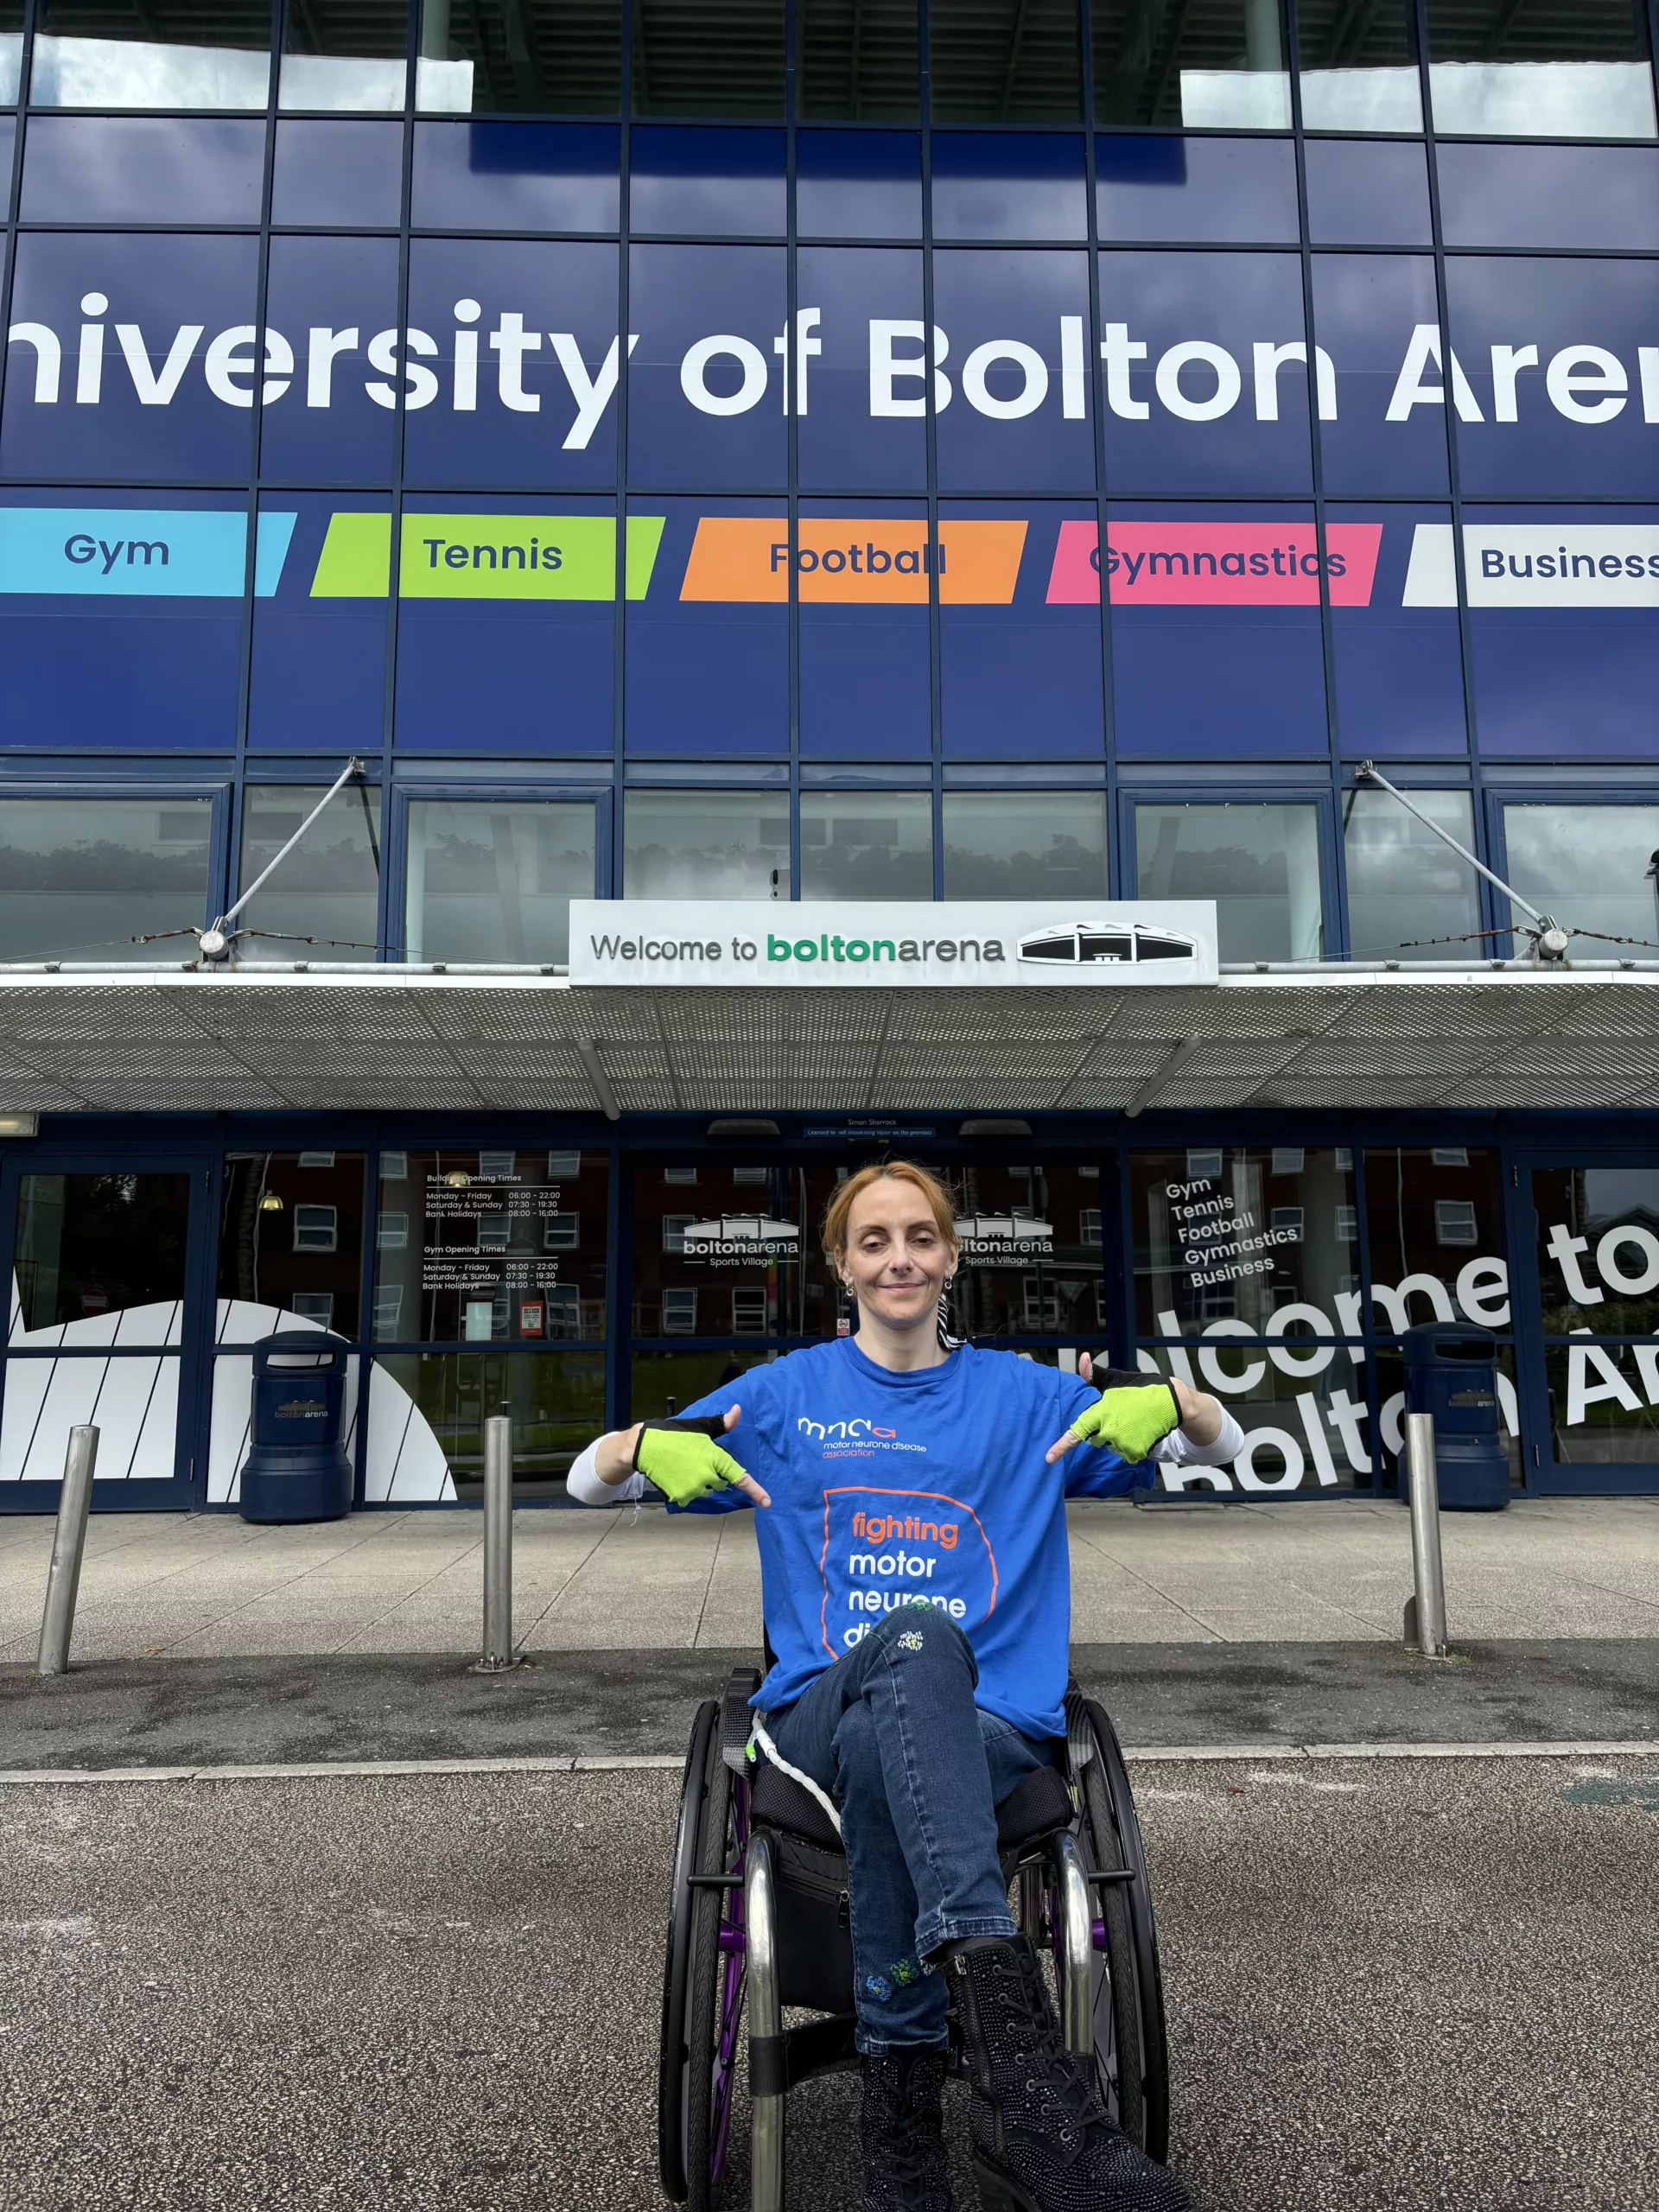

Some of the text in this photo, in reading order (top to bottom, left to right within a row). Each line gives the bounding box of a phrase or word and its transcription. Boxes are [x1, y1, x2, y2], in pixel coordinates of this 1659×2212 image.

[680, 308, 822, 416] of
[869, 315, 1338, 422] Bolton
[64, 534, 169, 575] Gym
[423, 537, 563, 570] Tennis
[770, 543, 946, 575] Football
[1090, 544, 1346, 585] Gymnastics
[590, 933, 1006, 962] Welcome to boltonarena
[427, 1173, 522, 1184] Building Opening Times
[426, 1192, 460, 1202] Monday
[467, 1192, 493, 1202] Friday
[1166, 1179, 1211, 1201] Gym
[425, 1201, 463, 1211] Saturday
[472, 1201, 503, 1211] Sunday
[508, 1200, 530, 1209] 07:30
[447, 1211, 482, 1219] Holidays
[1171, 1194, 1235, 1221] Tennis
[1177, 1211, 1255, 1244] Football
[423, 1245, 444, 1255] Gym
[445, 1245, 480, 1255] Opening
[683, 1240, 799, 1255] boltonarena
[1185, 1228, 1298, 1267] Gymnastics
[423, 1264, 456, 1273] Monday
[464, 1263, 490, 1273] Friday
[506, 1262, 529, 1271] 06:00
[537, 1262, 559, 1271] 22:00
[709, 1257, 774, 1268] Sports Village
[965, 1255, 1029, 1268] Sports Village
[1190, 1257, 1275, 1288] Business
[1547, 1224, 1659, 1305] to
[423, 1273, 461, 1282] Saturday
[470, 1273, 501, 1282] Sunday
[505, 1272, 528, 1281] 07:30
[444, 1282, 480, 1291] Holidays
[823, 1449, 874, 1459] association
[851, 1440, 891, 1450] neurone
[891, 1441, 927, 1452] disease
[852, 1511, 959, 1549] fighting
[849, 1550, 937, 1578] motor
